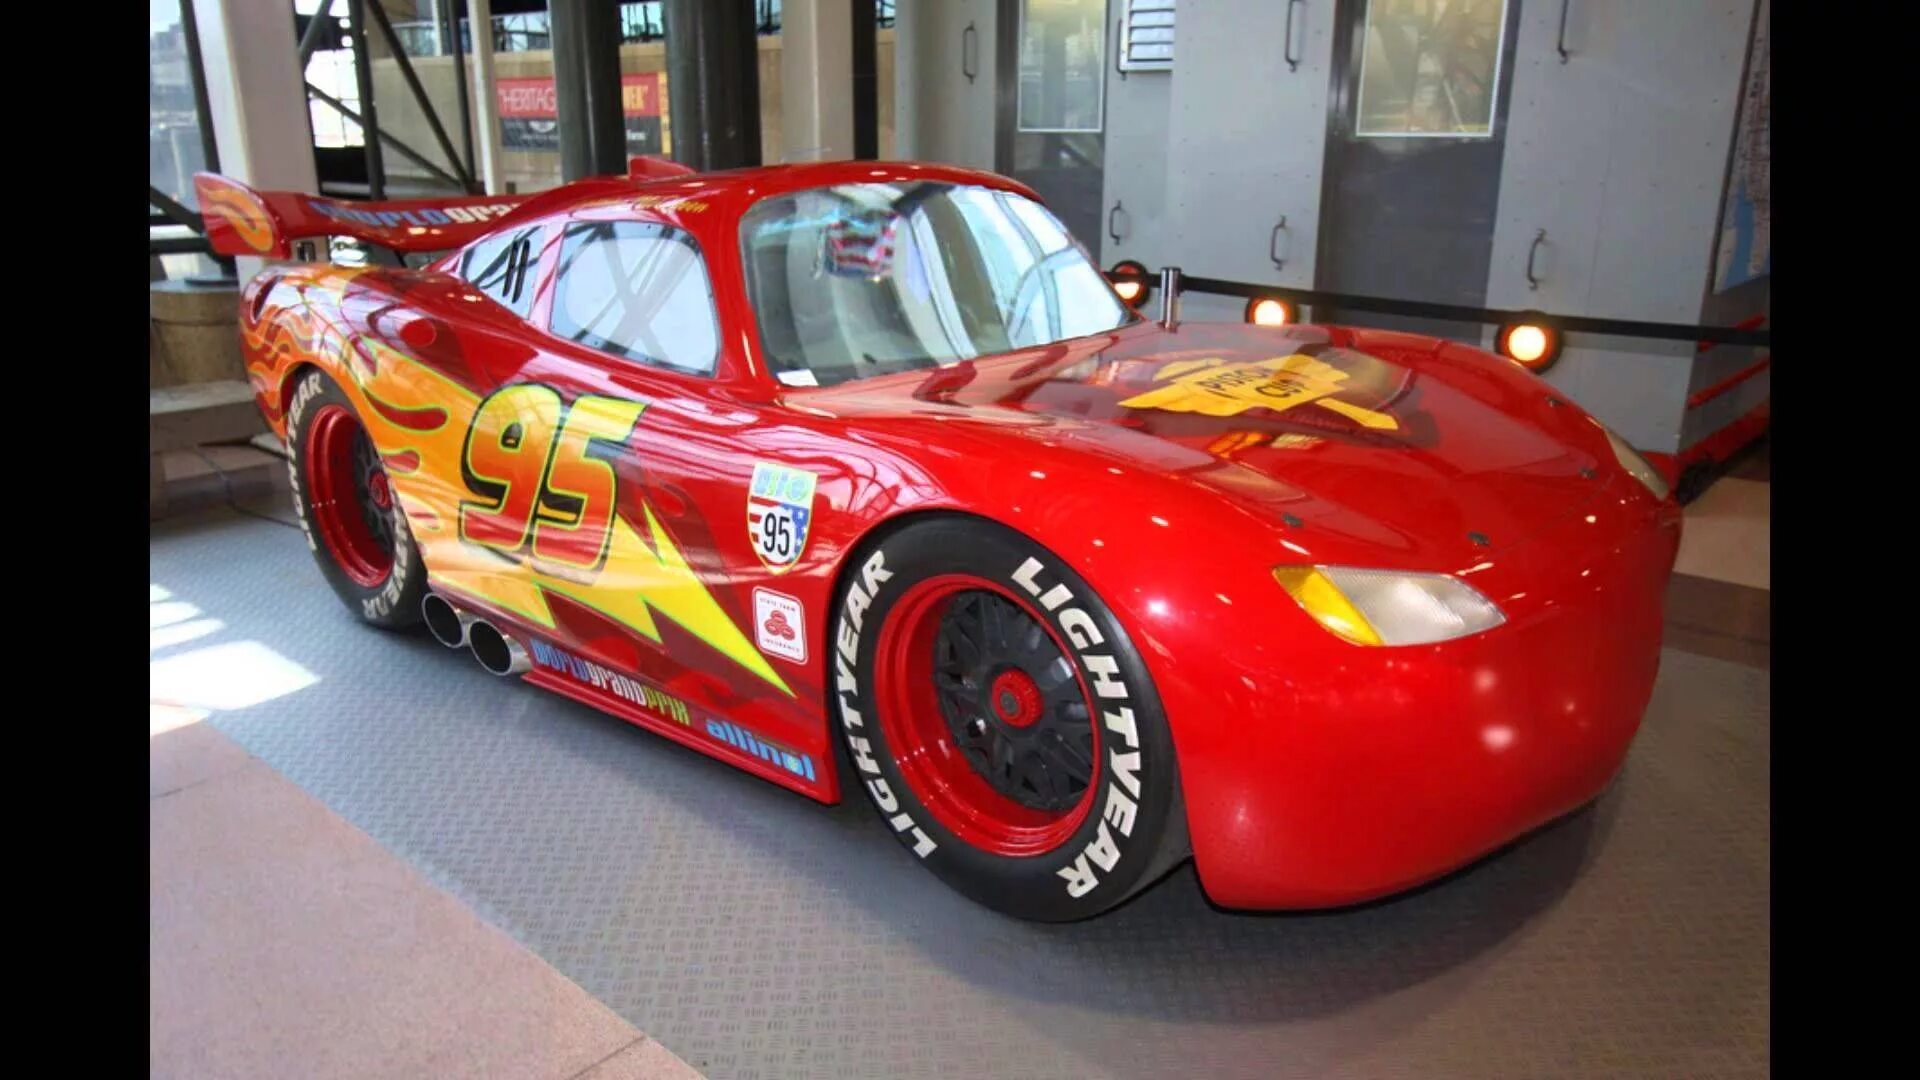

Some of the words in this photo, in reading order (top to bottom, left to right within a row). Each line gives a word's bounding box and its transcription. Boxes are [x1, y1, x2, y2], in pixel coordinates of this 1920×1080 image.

[459, 382, 650, 580] 95
[763, 512, 790, 557] 95
[706, 719, 816, 782] allinol
[835, 550, 939, 859] LIGHTYEAR
[1010, 556, 1142, 899] LIGHTYEAR
